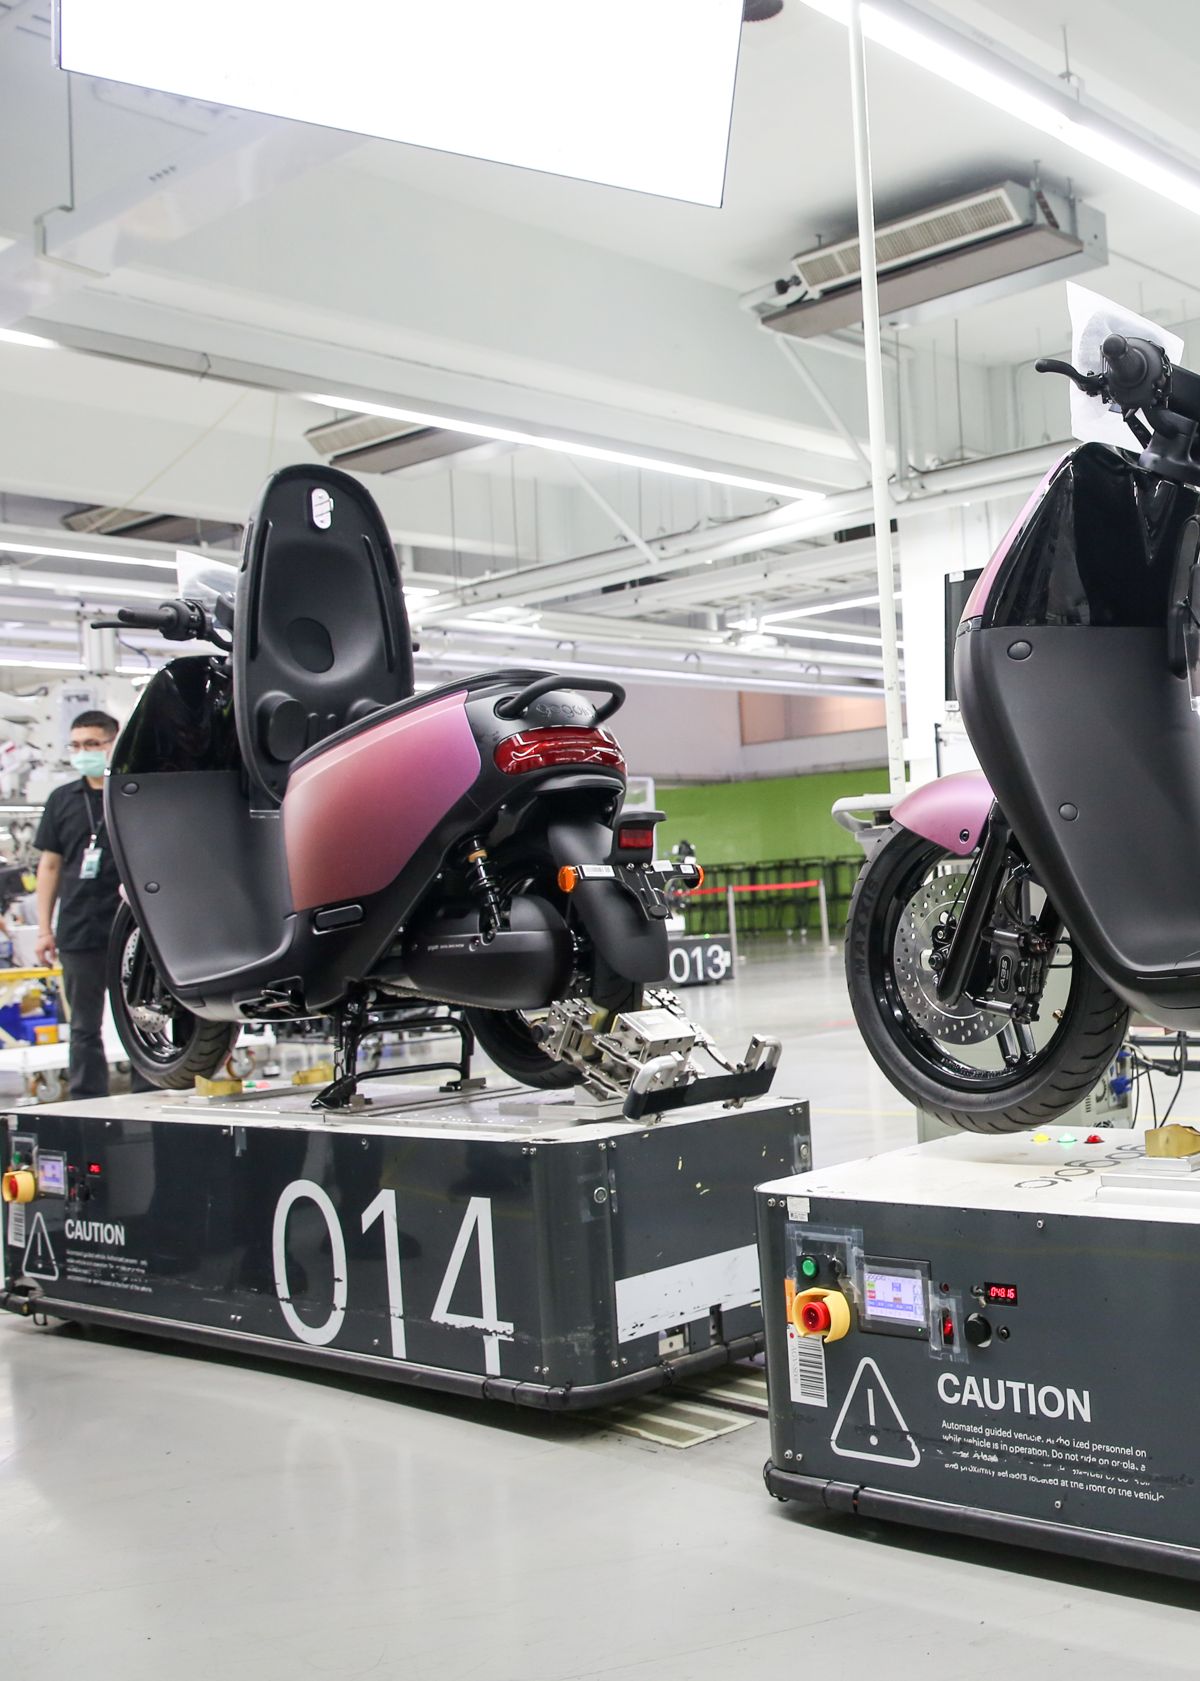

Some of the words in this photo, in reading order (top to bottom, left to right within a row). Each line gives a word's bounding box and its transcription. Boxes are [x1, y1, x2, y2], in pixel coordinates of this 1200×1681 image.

[853, 879, 878, 975] MAXXIS
[669, 944, 726, 983] 013
[1000, 960, 1009, 988] ABS
[65, 1218, 125, 1246] CAUTION
[272, 1180, 514, 1375] 014
[937, 1372, 1092, 1423] CAUTION
[942, 1420, 983, 1434] Automated
[984, 1427, 1012, 1439] guided
[1092, 1442, 1134, 1457] personnel
[1135, 1449, 1147, 1458] on
[992, 1442, 999, 1450] is
[1000, 1440, 1008, 1451] in
[1009, 1445, 1050, 1458] operation.
[1051, 1449, 1064, 1460] Do
[1065, 1452, 1079, 1462] not
[1098, 1457, 1110, 1466] on
[1111, 1459, 1120, 1467] or
[1060, 1480, 1069, 1488] at
[1070, 1481, 1084, 1490] the
[1107, 1486, 1116, 1495] of
[1118, 1488, 1132, 1498] the
